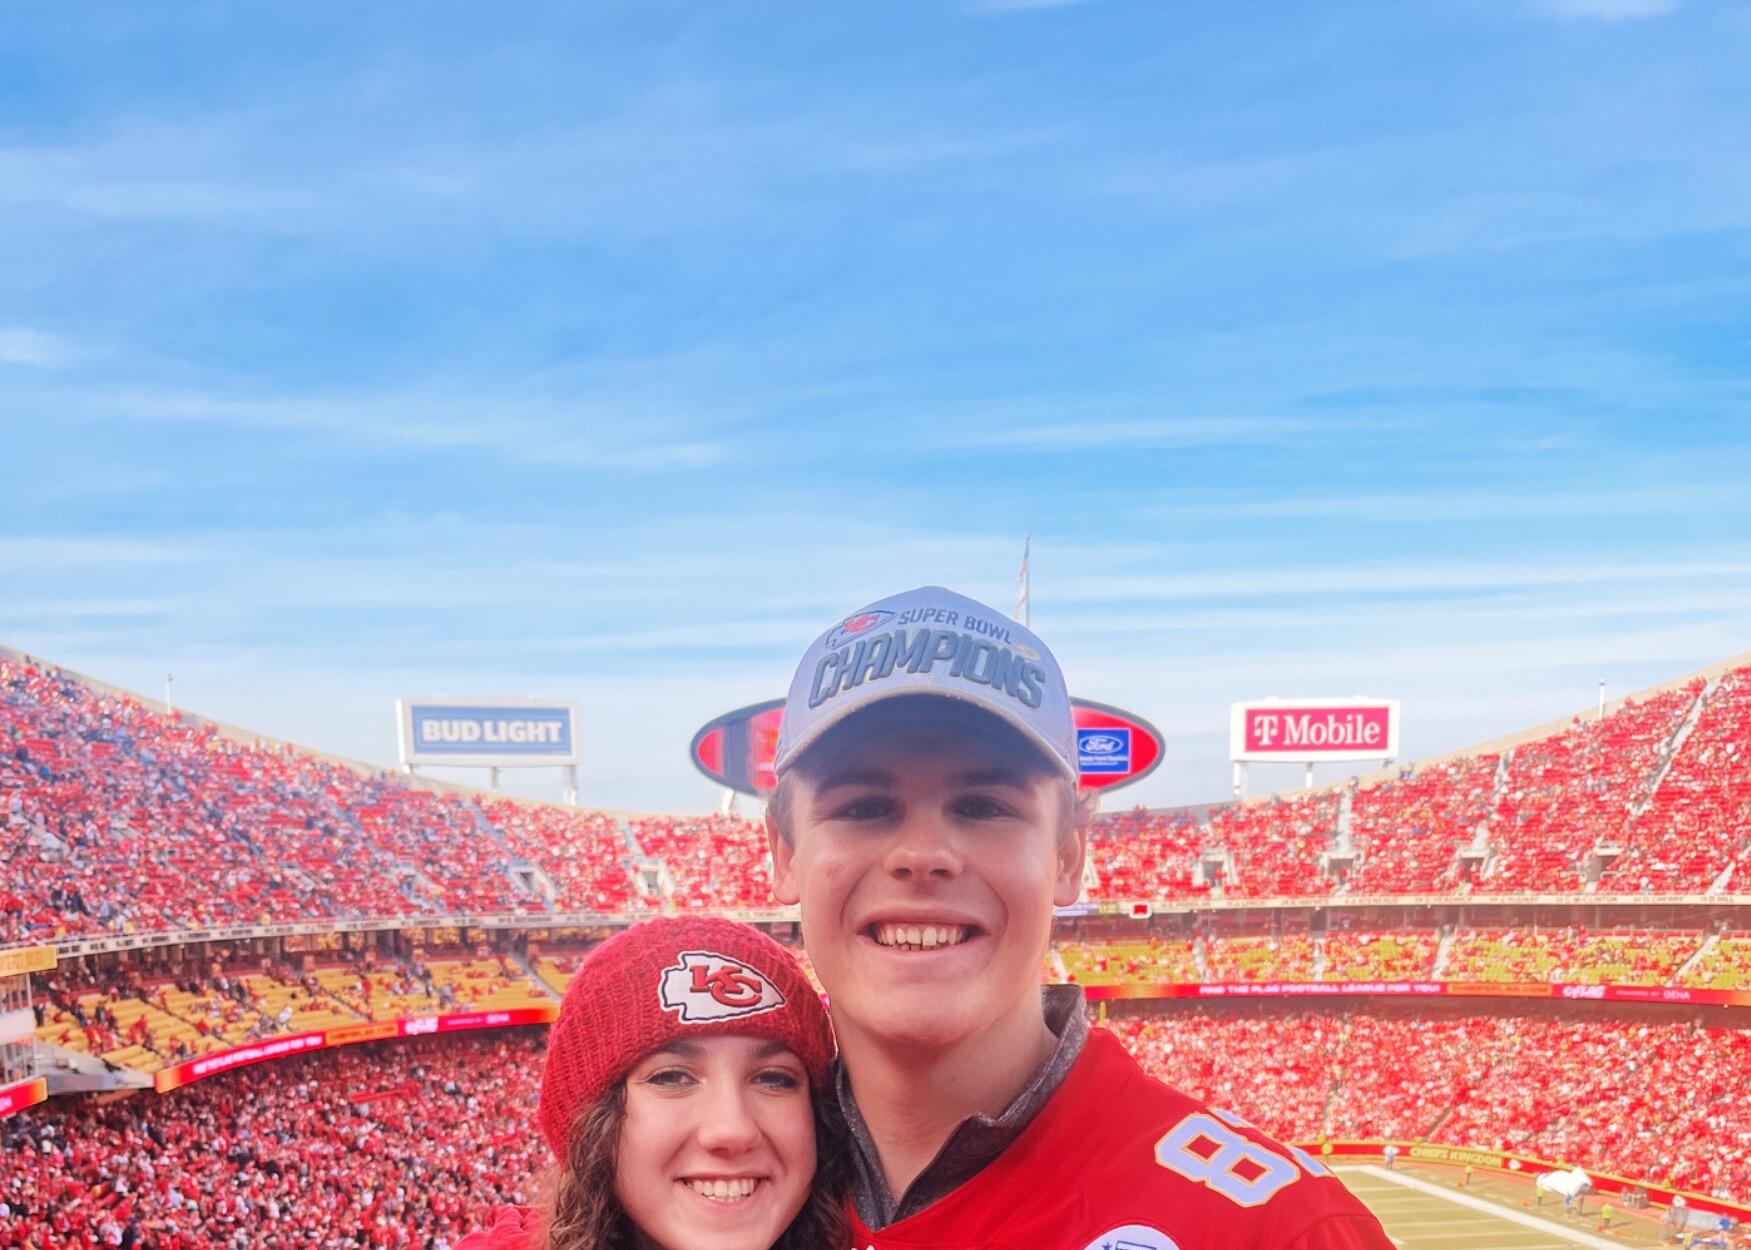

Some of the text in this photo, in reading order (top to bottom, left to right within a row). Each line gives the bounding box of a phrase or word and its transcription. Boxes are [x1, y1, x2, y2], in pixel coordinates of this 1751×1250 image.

[897, 608, 1012, 644] SUPER BOWL
[808, 628, 1046, 709] CHAMPIONS
[421, 719, 563, 743] BUD LIGHT
[1253, 713, 1380, 746] T Mobile
[689, 965, 762, 1008] KC
